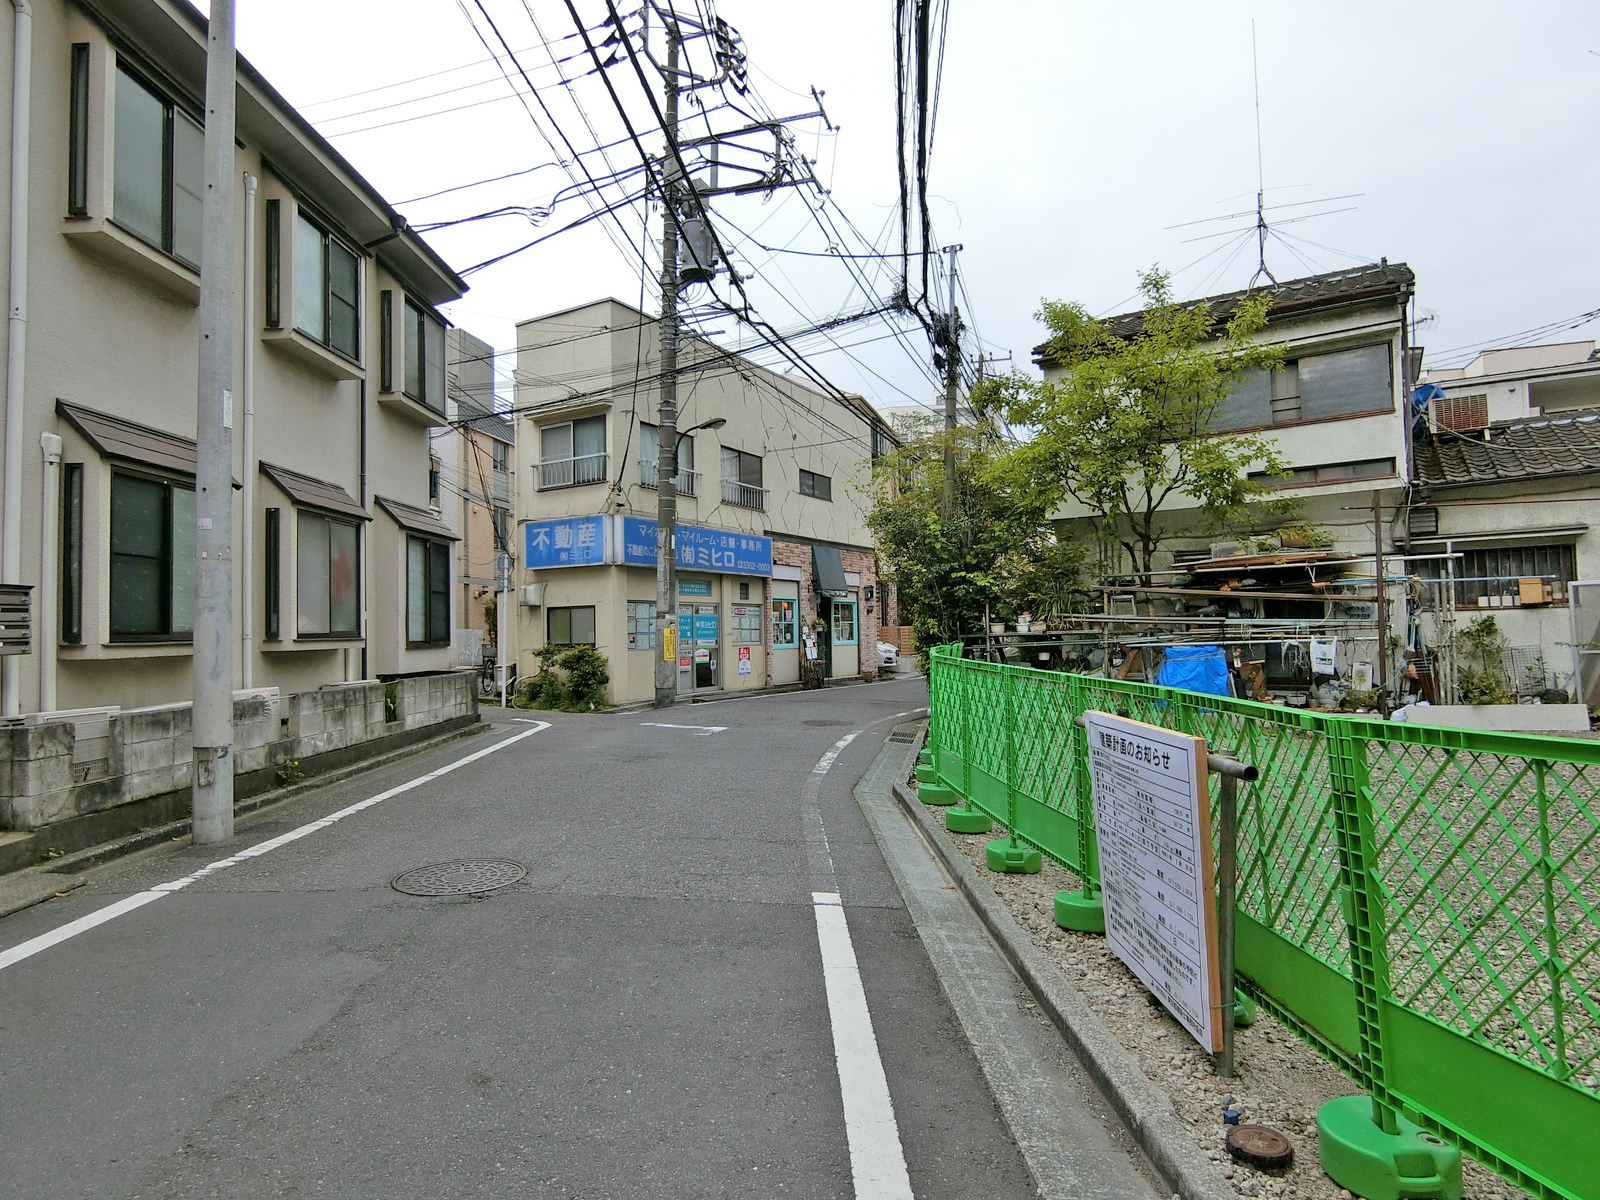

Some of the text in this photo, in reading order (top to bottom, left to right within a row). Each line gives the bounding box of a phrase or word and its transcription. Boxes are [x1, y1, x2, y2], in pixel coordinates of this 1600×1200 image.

[532, 523, 597, 551] 不動産
[1098, 731, 1170, 770] 建築計画のお知らせ
